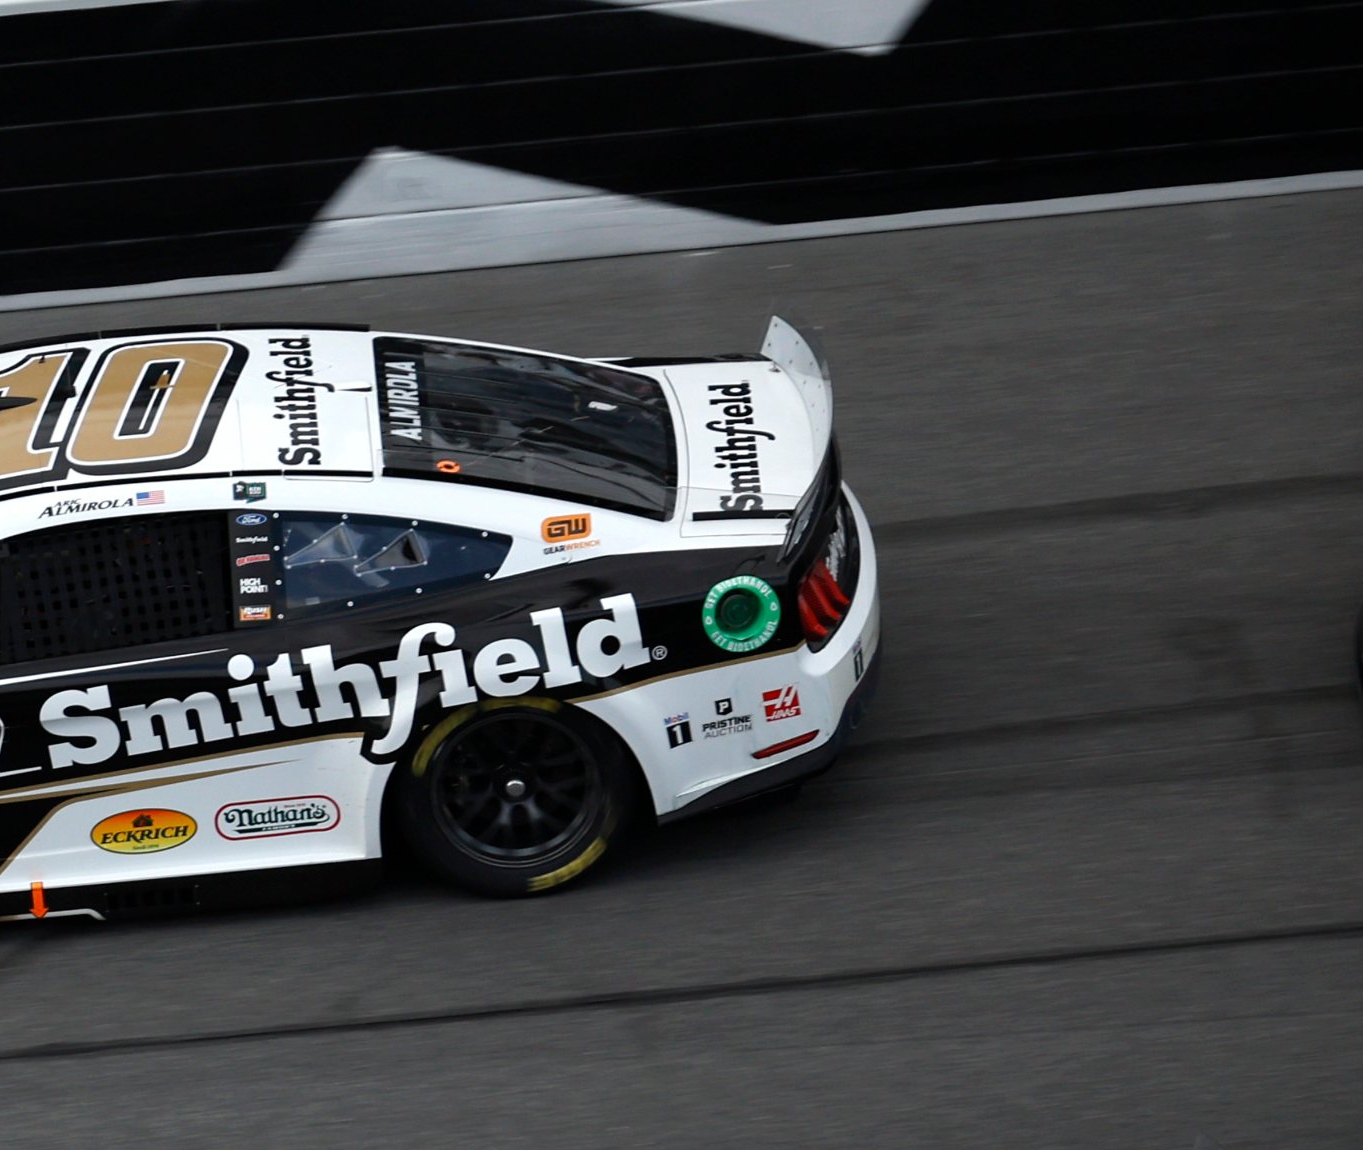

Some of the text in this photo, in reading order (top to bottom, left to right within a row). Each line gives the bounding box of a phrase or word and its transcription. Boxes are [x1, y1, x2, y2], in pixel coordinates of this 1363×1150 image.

[265, 337, 335, 466] Smithfield
[385, 361, 423, 441] ALMIROLA
[706, 381, 775, 511] Smithfield
[38, 498, 133, 519] ALMIROLA
[543, 539, 602, 555] GEARWRENCH
[240, 578, 261, 586] HIGH
[39, 592, 654, 768] Smithfield
[663, 712, 690, 726] Mobil
[702, 714, 753, 732] PRISTINE
[704, 724, 754, 740] AUCTION
[224, 803, 330, 828] Nathan's
[100, 825, 189, 845] ECKRICH
